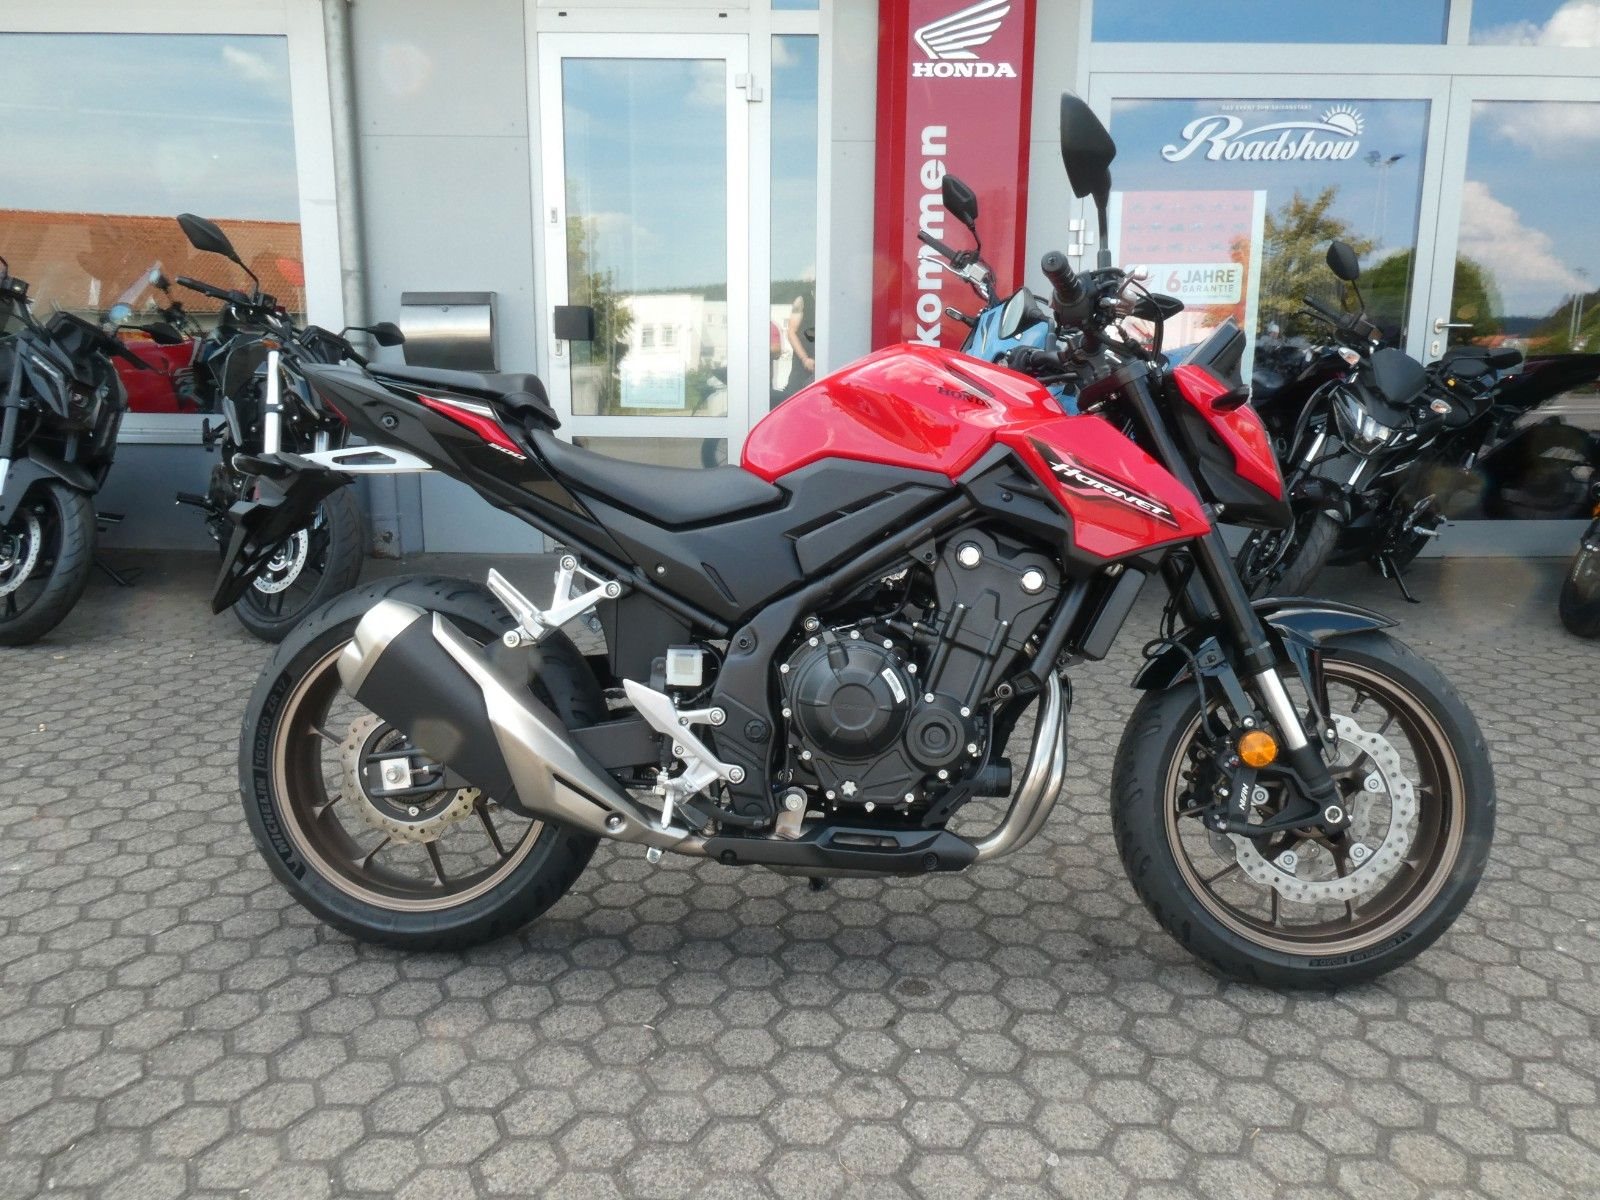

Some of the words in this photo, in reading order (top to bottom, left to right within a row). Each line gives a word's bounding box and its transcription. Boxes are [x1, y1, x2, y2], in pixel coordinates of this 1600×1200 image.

[912, 62, 1017, 78] HONDA
[1162, 114, 1361, 162] Roadshow
[1166, 270, 1182, 293] 6
[1182, 269, 1236, 284] JAHRE
[1182, 284, 1235, 294] GARANTIE
[1049, 460, 1171, 515] HORNET
[255, 715, 273, 765] 160/60
[255, 776, 291, 856] MICHELIN
